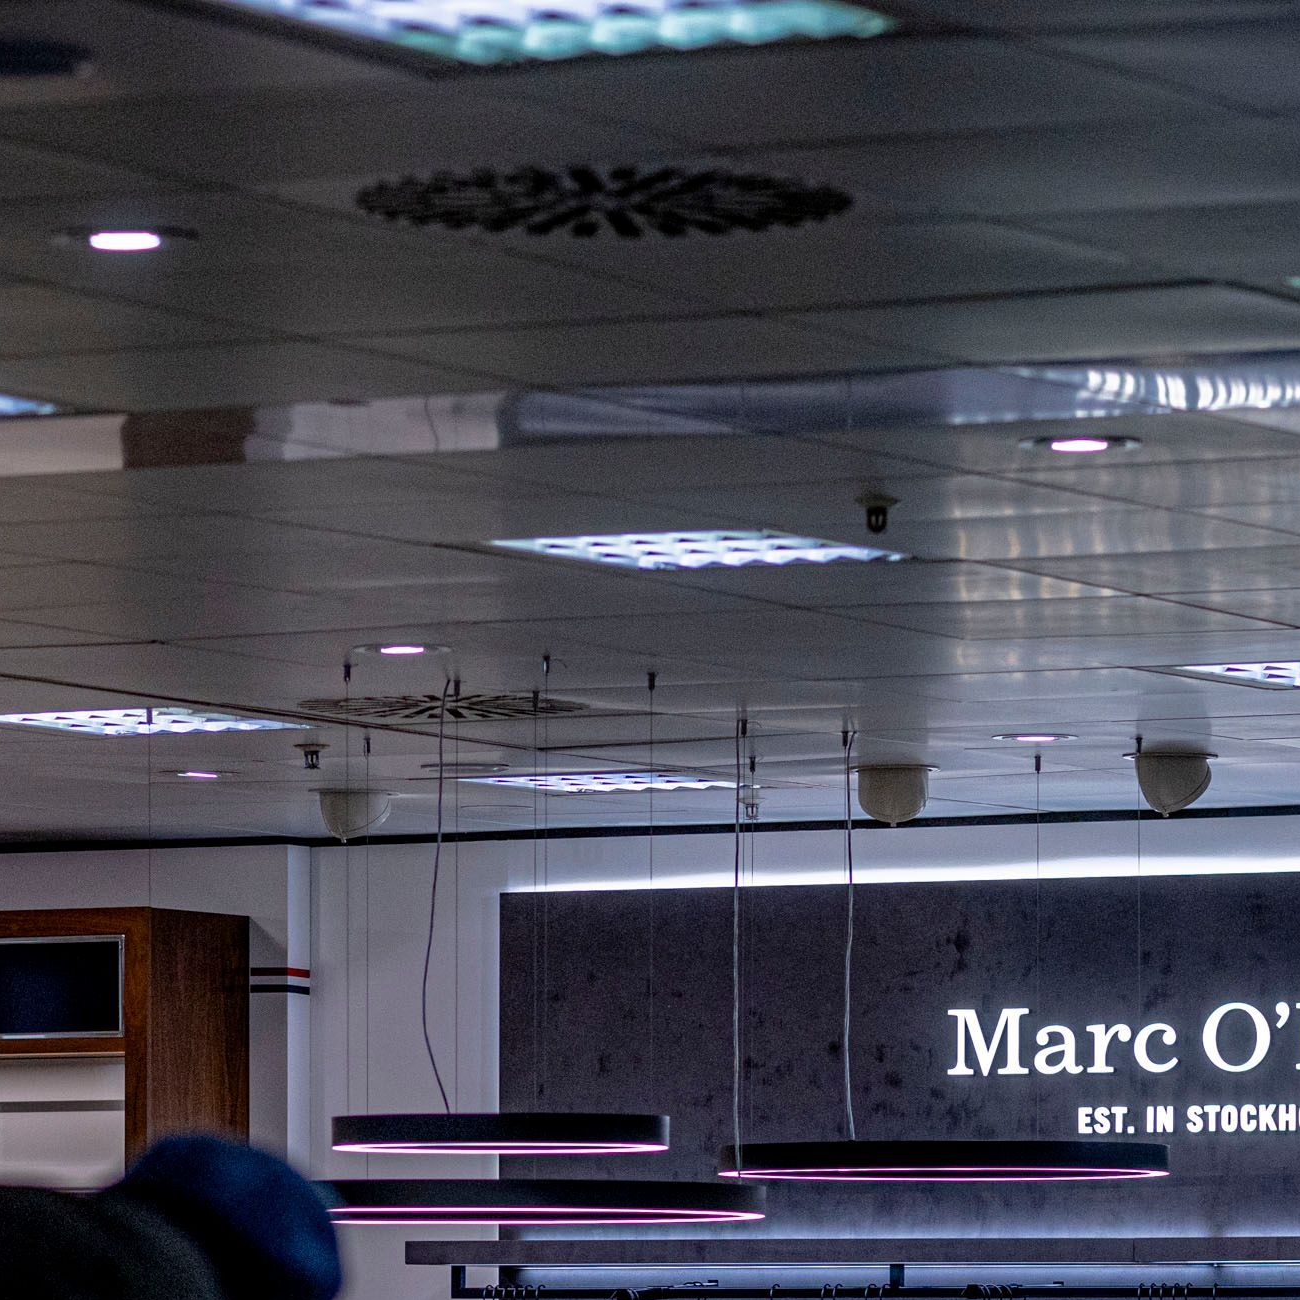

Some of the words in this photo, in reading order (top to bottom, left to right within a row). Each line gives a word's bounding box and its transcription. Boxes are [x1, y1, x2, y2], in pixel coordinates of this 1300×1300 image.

[947, 1007, 1179, 1078] Marc
[1077, 1105, 1135, 1135] EST.
[1146, 1105, 1174, 1133] IN
